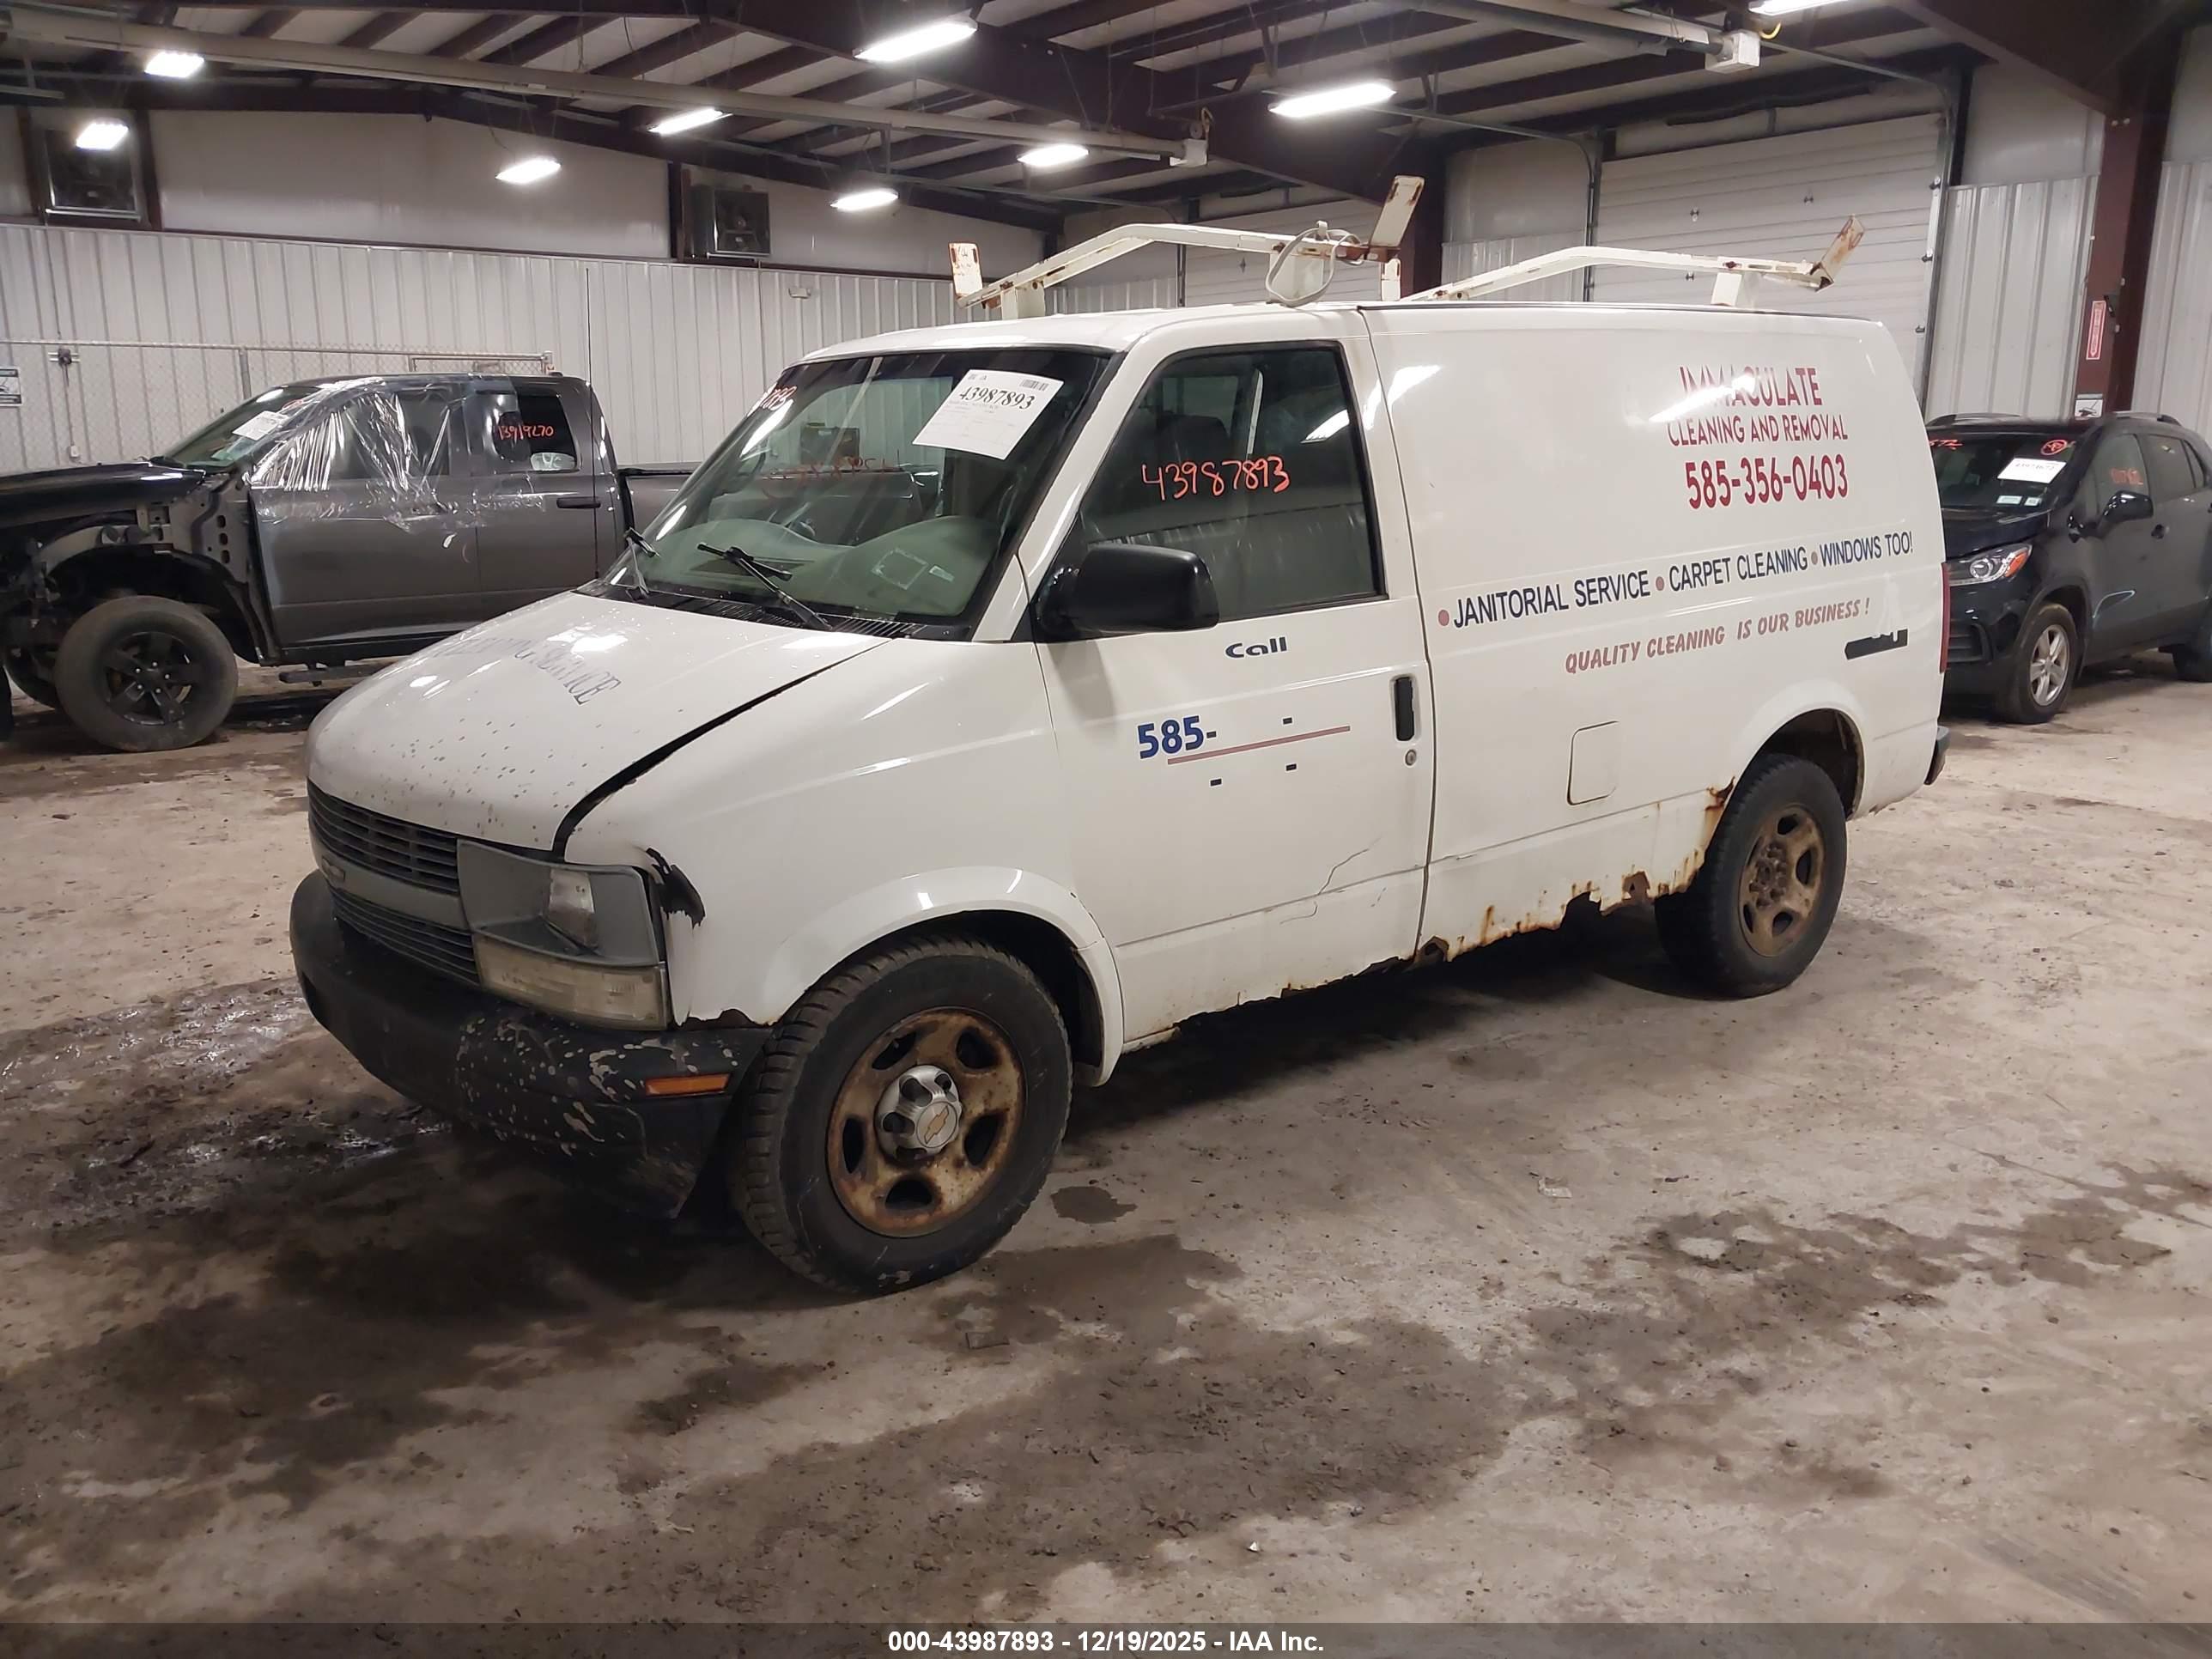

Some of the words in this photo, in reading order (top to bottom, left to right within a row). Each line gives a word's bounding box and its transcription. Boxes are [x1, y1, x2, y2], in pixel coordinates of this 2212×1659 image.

[958, 386, 1036, 410] 43987893
[1668, 414, 1745, 447] CLEANING
[1751, 416, 1779, 442] AND
[1782, 413, 1848, 441] REMOVAL
[1141, 454, 1291, 501] 43987893
[1685, 453, 1848, 509] 585-356-0403
[1454, 584, 1570, 628] JANITORIAL
[1573, 570, 1650, 607] SERVICE
[1668, 557, 1731, 592] CARPET
[1736, 546, 1808, 580] CLEANING
[1819, 535, 1881, 568] WINDOWS
[1884, 531, 1913, 556] TOO!
[1225, 636, 1288, 658] Call
[1565, 641, 1641, 674] QUALITY
[1646, 626, 1725, 658] CLEANING
[1737, 619, 1753, 640] IS
[1757, 613, 1789, 635] OUR
[1795, 599, 1861, 628] BUSINESS
[1138, 715, 1217, 759] 585-
